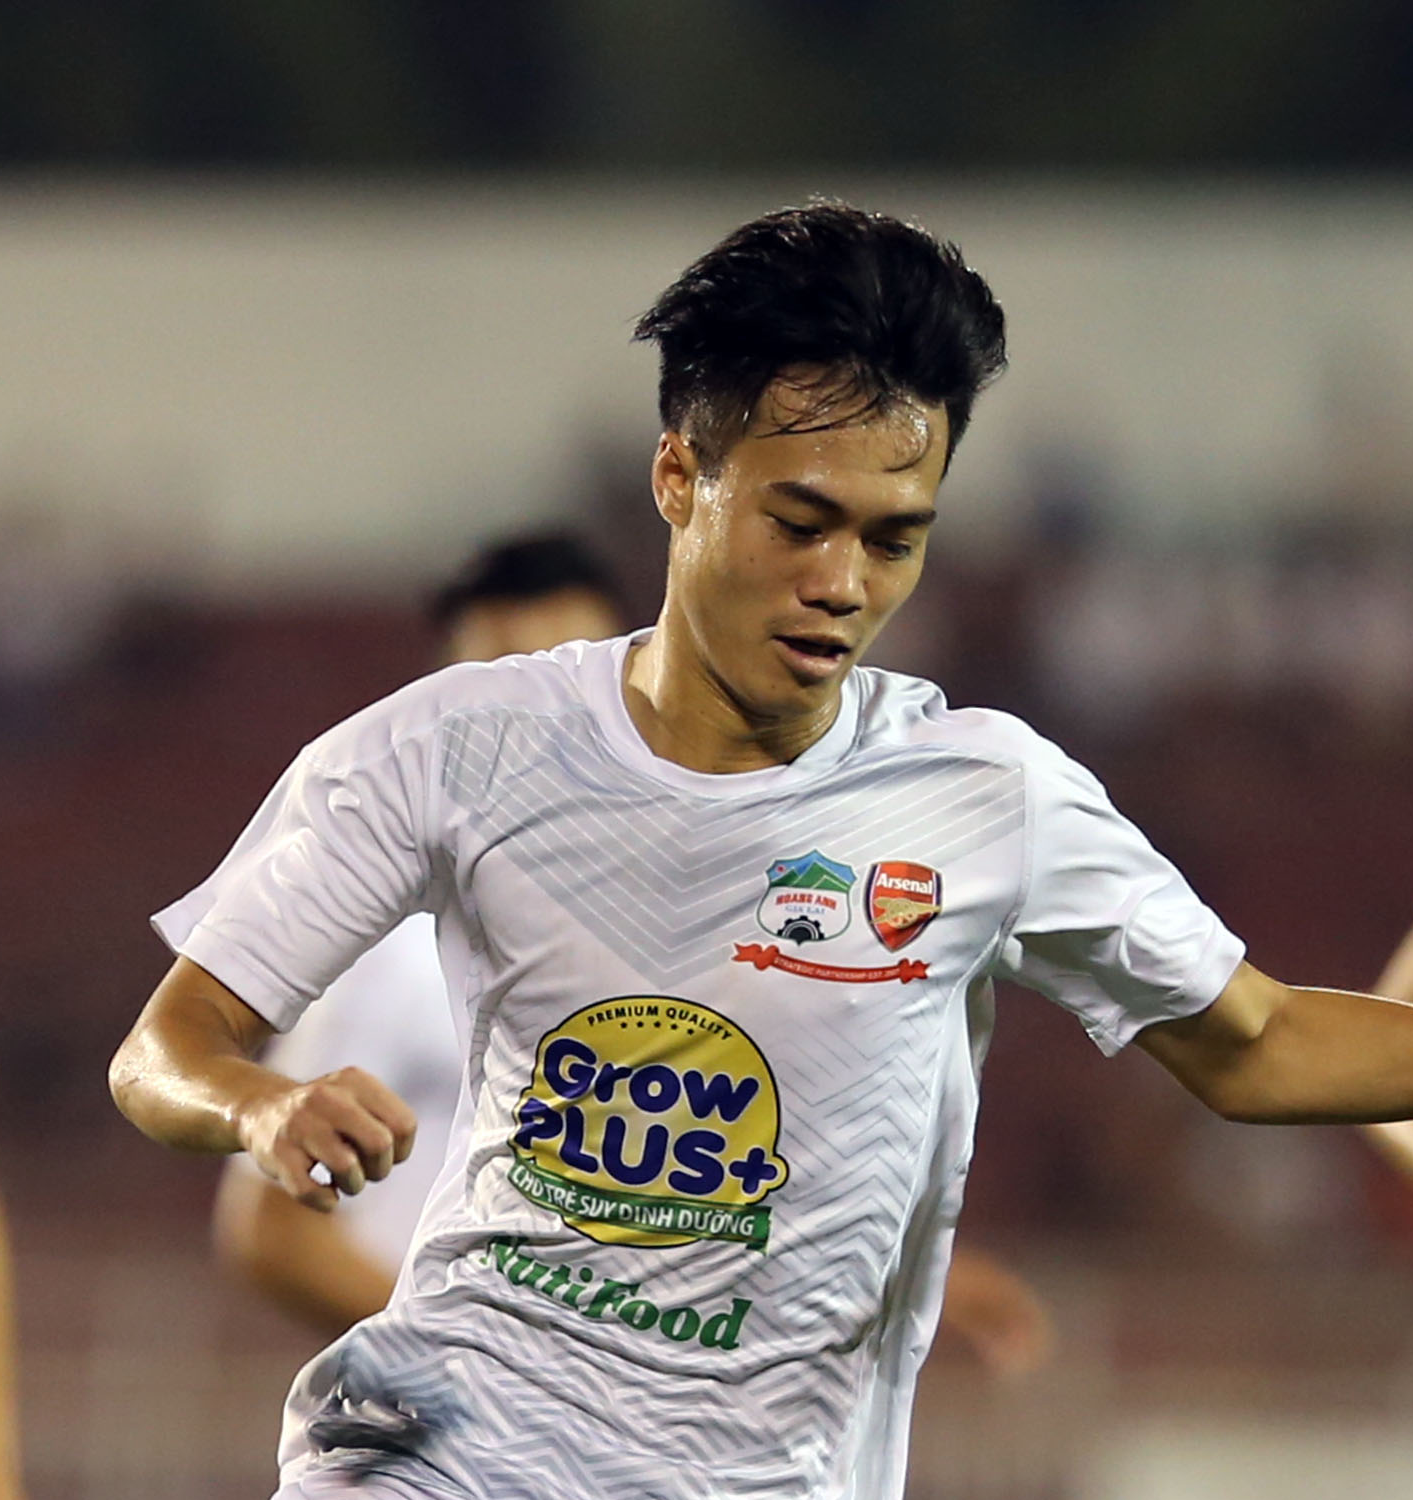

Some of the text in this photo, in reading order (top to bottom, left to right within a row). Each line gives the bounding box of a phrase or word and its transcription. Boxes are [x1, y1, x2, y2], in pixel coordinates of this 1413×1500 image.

[876, 873, 933, 895] Arsenal
[587, 1005, 733, 1041] PREMIUM QUALITY
[543, 1038, 759, 1122] Grow
[515, 1098, 778, 1196] PLUS+
[511, 1164, 543, 1198] CHO
[577, 1194, 619, 1219] SUY
[618, 1204, 675, 1229] DINH
